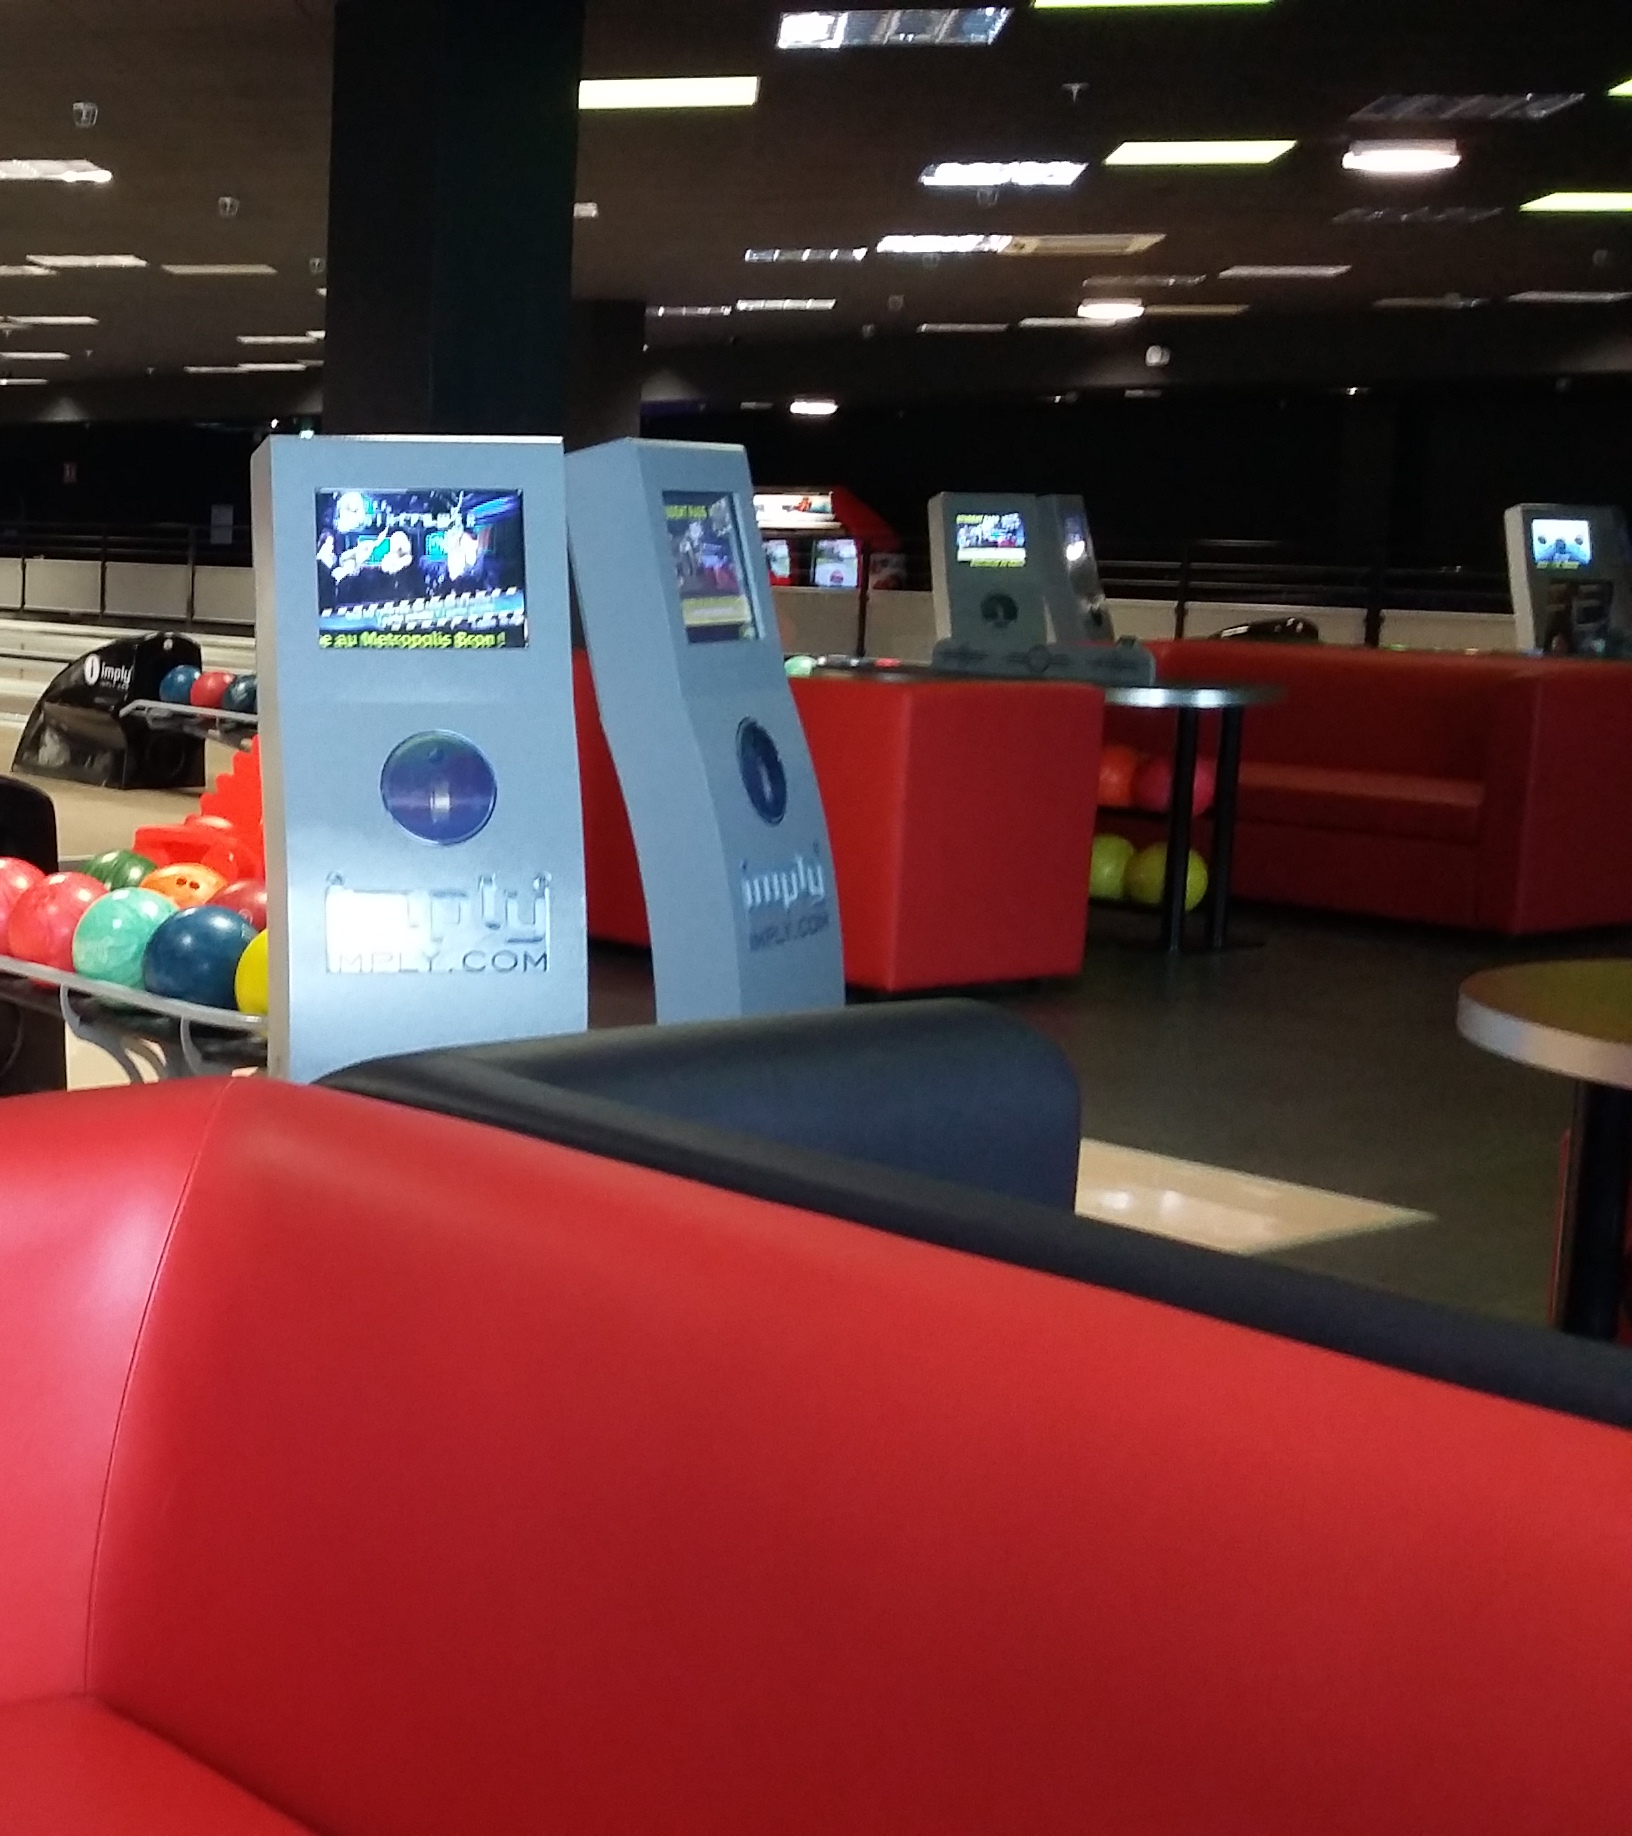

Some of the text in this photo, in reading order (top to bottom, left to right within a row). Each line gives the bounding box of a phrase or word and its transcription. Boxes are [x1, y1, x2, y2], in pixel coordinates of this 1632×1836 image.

[361, 631, 452, 649] Metropolis
[100, 661, 134, 688] imply
[740, 853, 826, 908] imply
[331, 950, 548, 974] MPLY.COM
